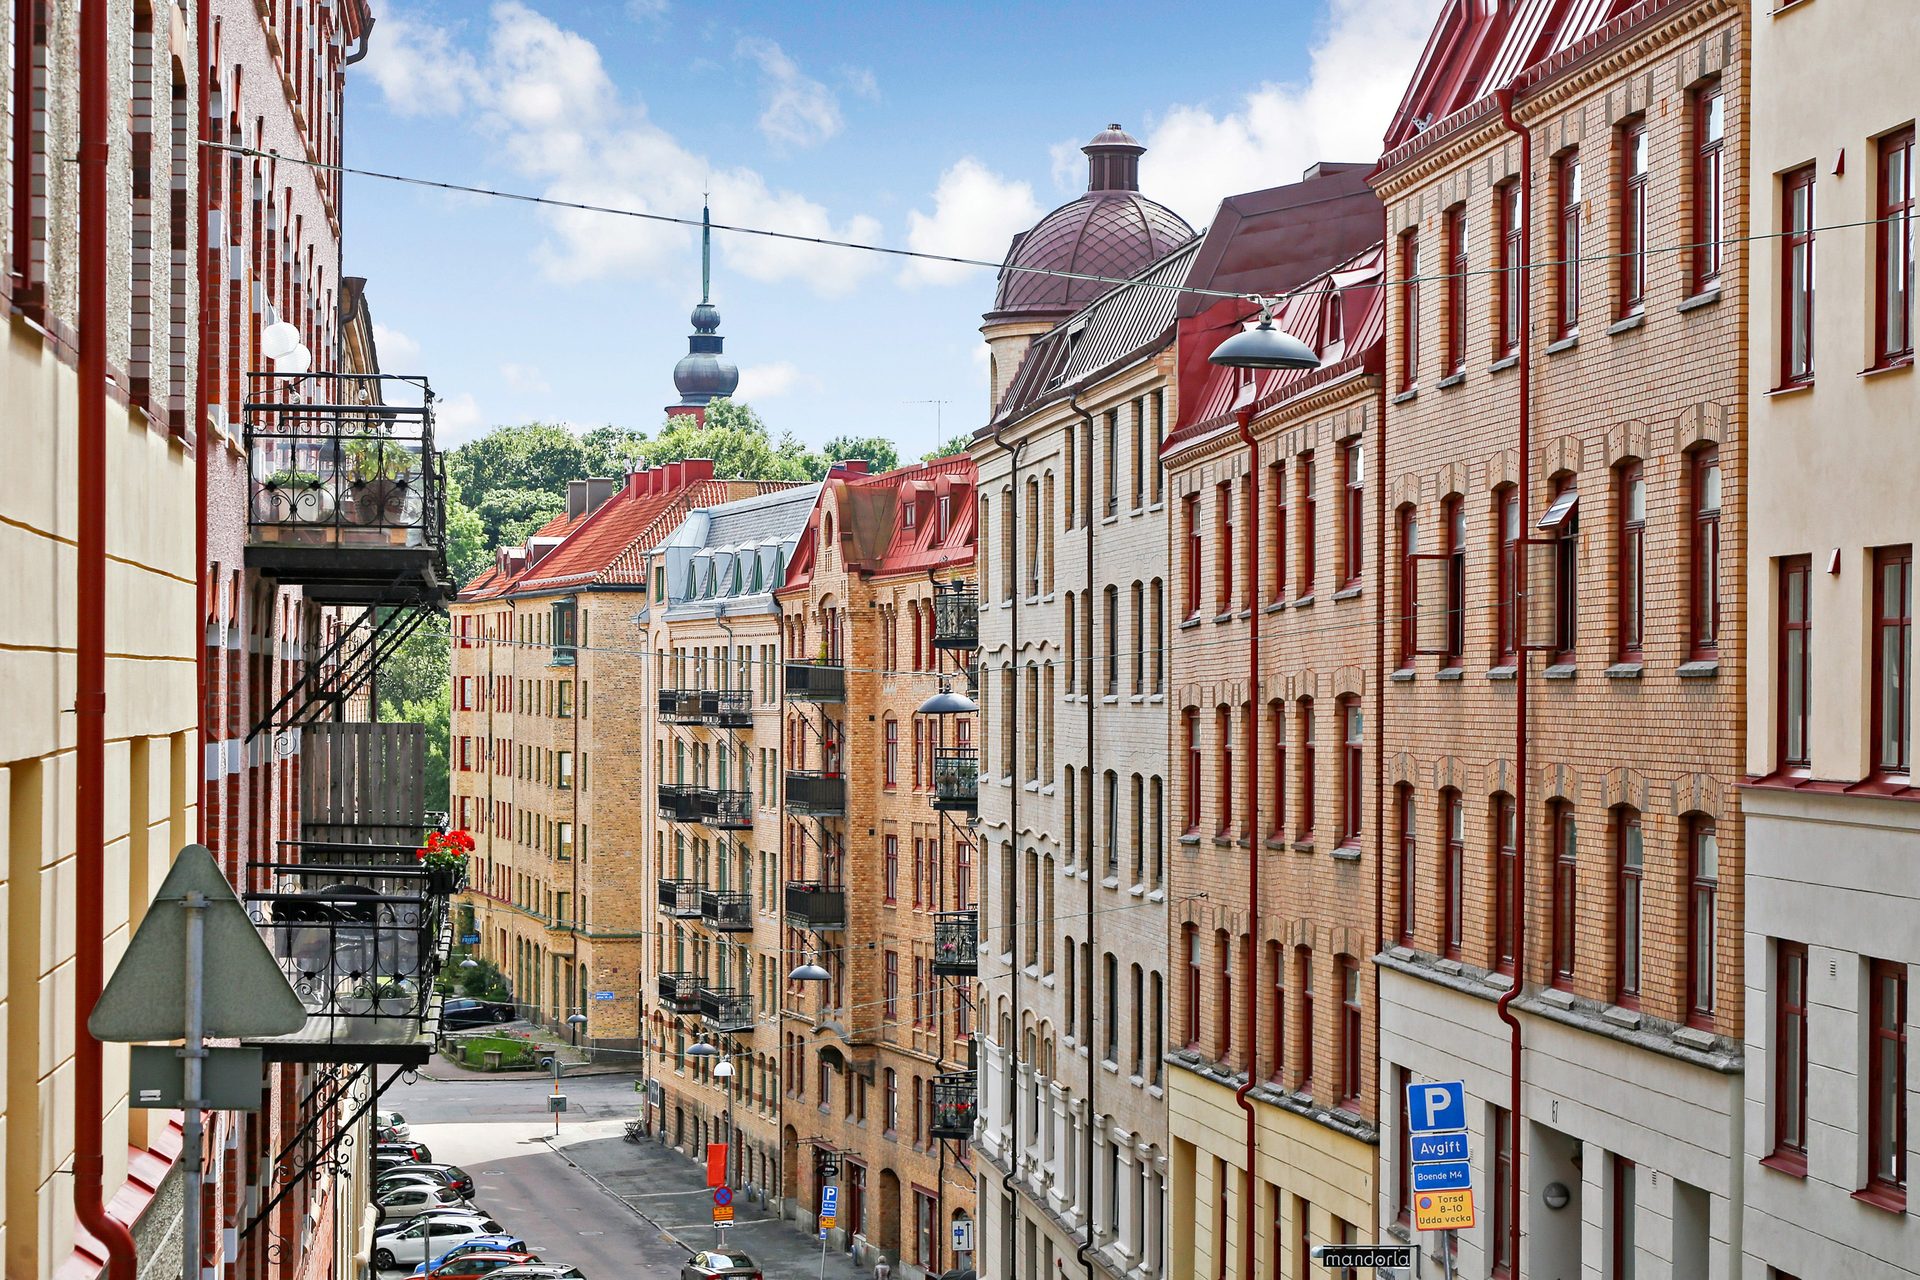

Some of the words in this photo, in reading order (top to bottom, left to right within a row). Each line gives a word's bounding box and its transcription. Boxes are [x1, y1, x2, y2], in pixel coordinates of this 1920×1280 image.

[1424, 1087, 1452, 1127] P
[1420, 1141, 1461, 1156] Avgift
[1417, 1172, 1447, 1181] Boende
[1449, 1170, 1463, 1179] M4
[826, 1188, 835, 1200] P
[1437, 1194, 1464, 1203] Torsd
[1440, 1204, 1463, 1213] 8-10
[1419, 1216, 1442, 1225] Udda
[1444, 1214, 1472, 1223] vecka
[1326, 1250, 1410, 1266] mandorla
